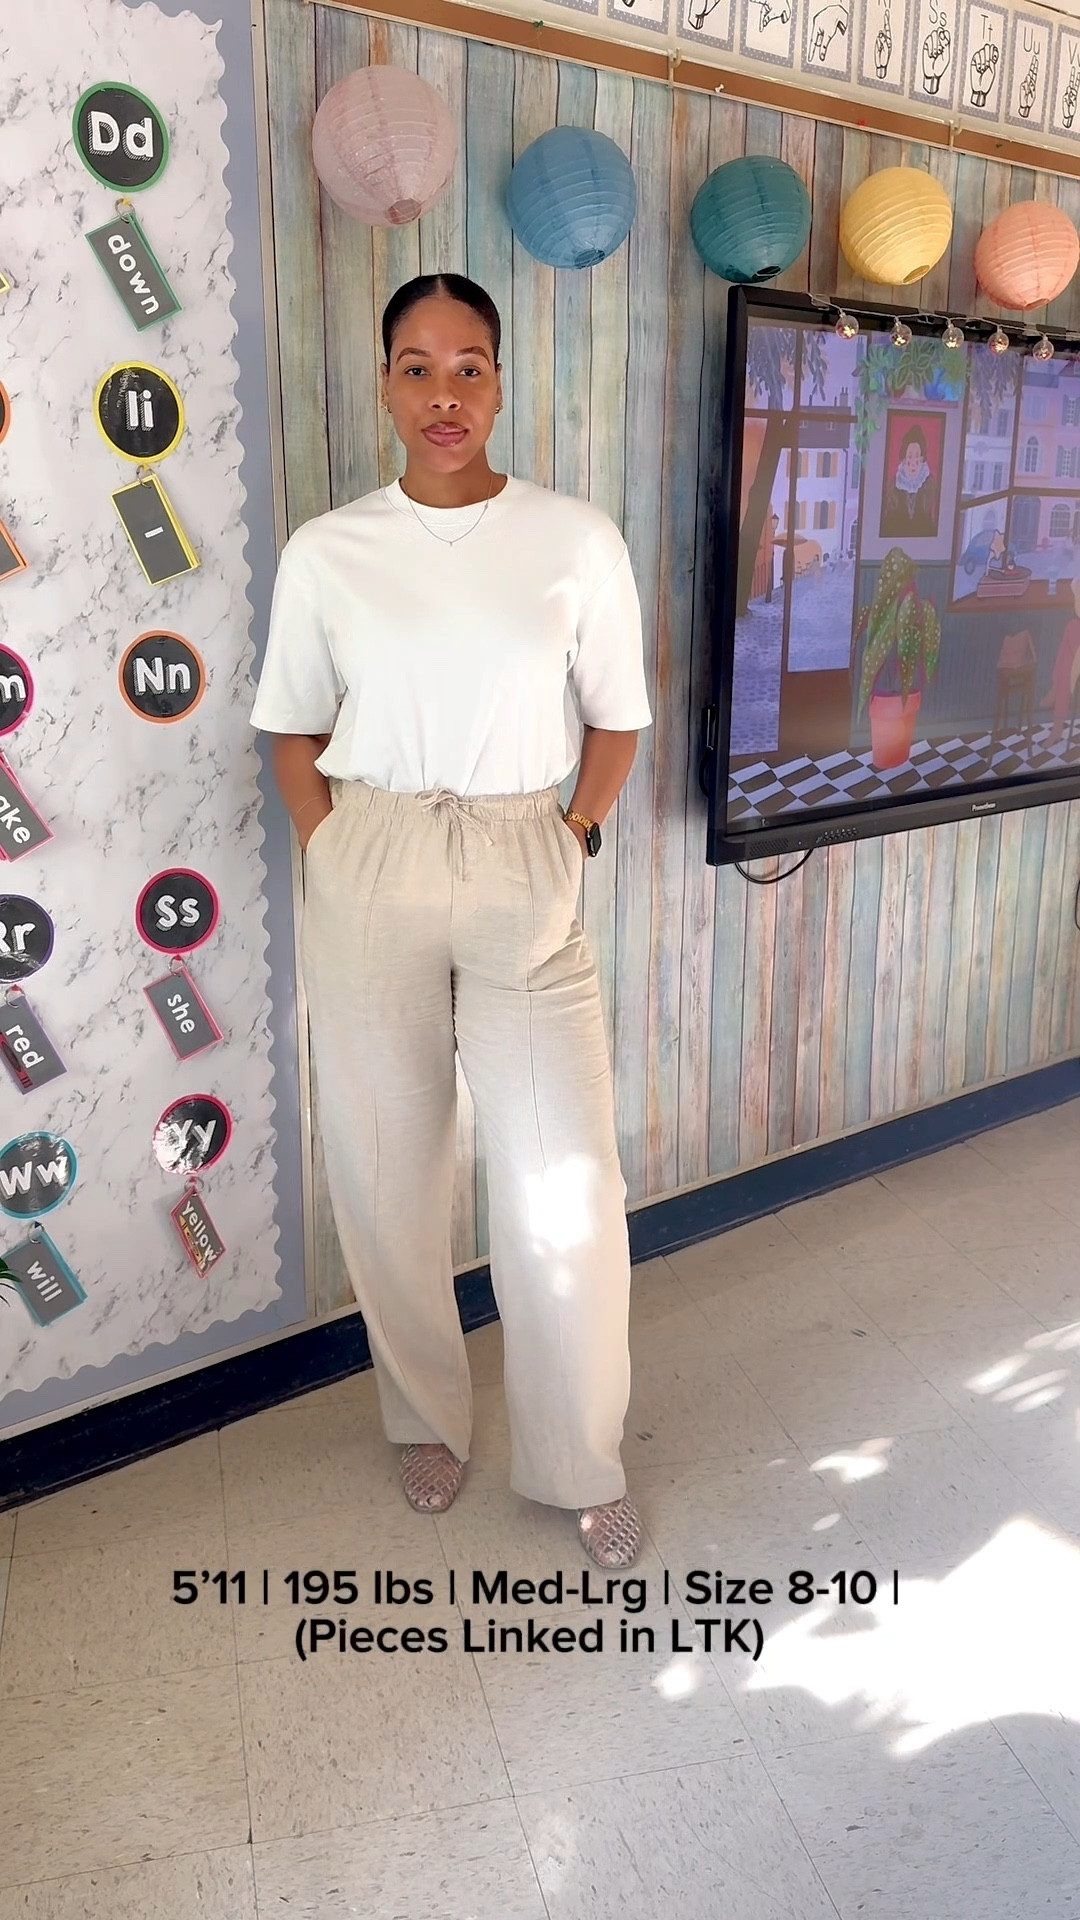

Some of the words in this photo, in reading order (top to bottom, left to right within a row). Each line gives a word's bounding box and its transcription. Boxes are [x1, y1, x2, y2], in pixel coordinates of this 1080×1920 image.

[980, 14, 993, 42] Tt
[1023, 26, 1041, 55] Uu
[87, 111, 154, 160] Dd
[107, 234, 160, 315] down
[133, 656, 191, 696] Nn
[155, 894, 200, 931] Ss
[167, 993, 195, 1034] she
[5, 1024, 45, 1069] red
[0, 1156, 68, 1199] Ww
[182, 1200, 217, 1261] yellow
[26, 1260, 62, 1303] will
